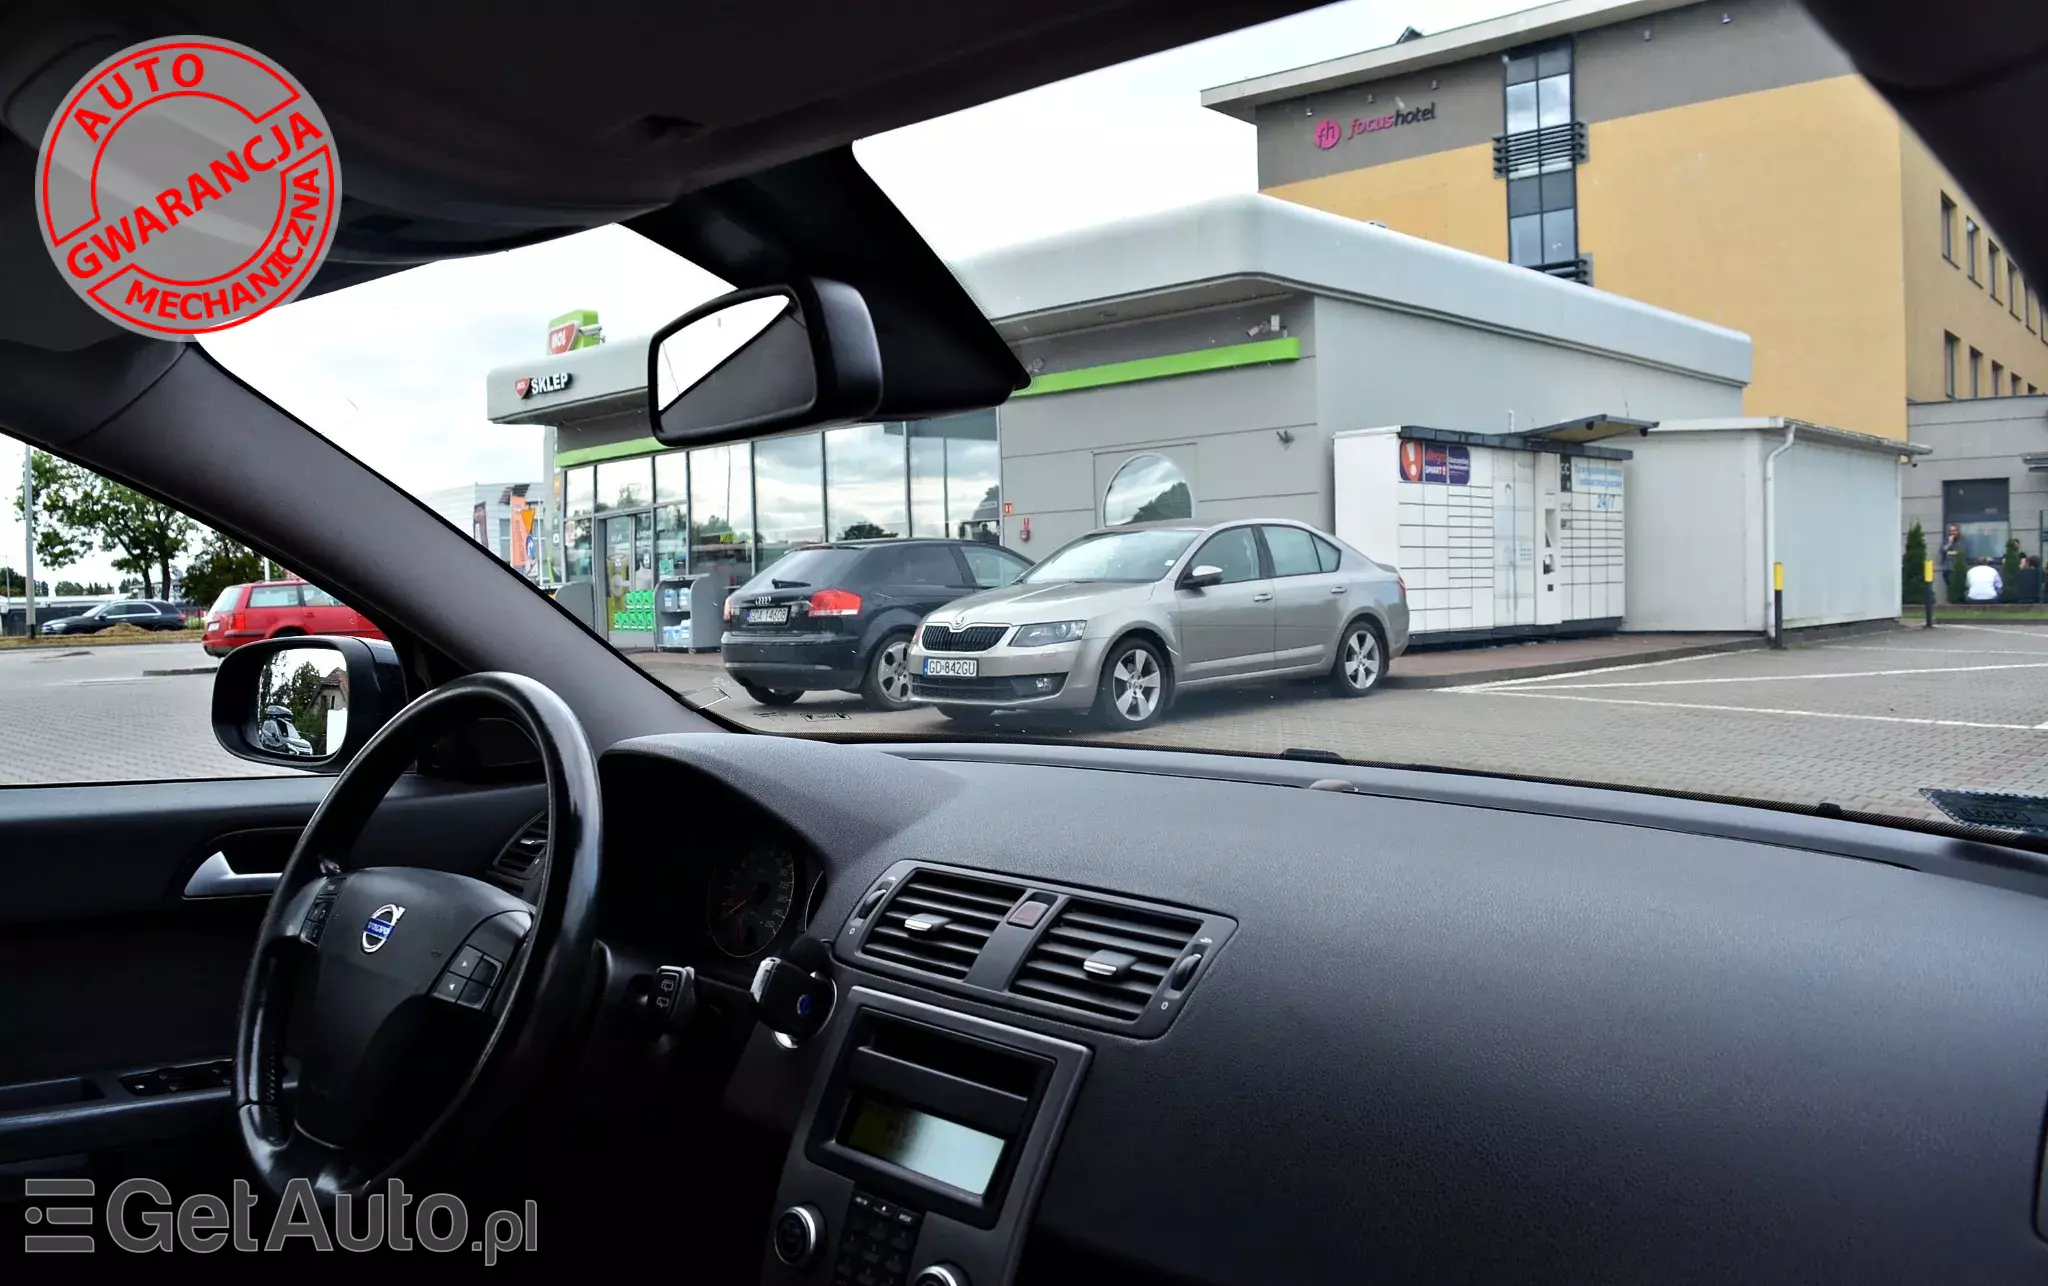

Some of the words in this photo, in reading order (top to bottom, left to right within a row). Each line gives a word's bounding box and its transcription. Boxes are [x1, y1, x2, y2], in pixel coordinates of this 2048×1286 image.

[1347, 102, 1436, 140] focushotel
[531, 372, 569, 395] SKLEP
[929, 660, 942, 674] GD
[944, 661, 976, 675] 842GU
